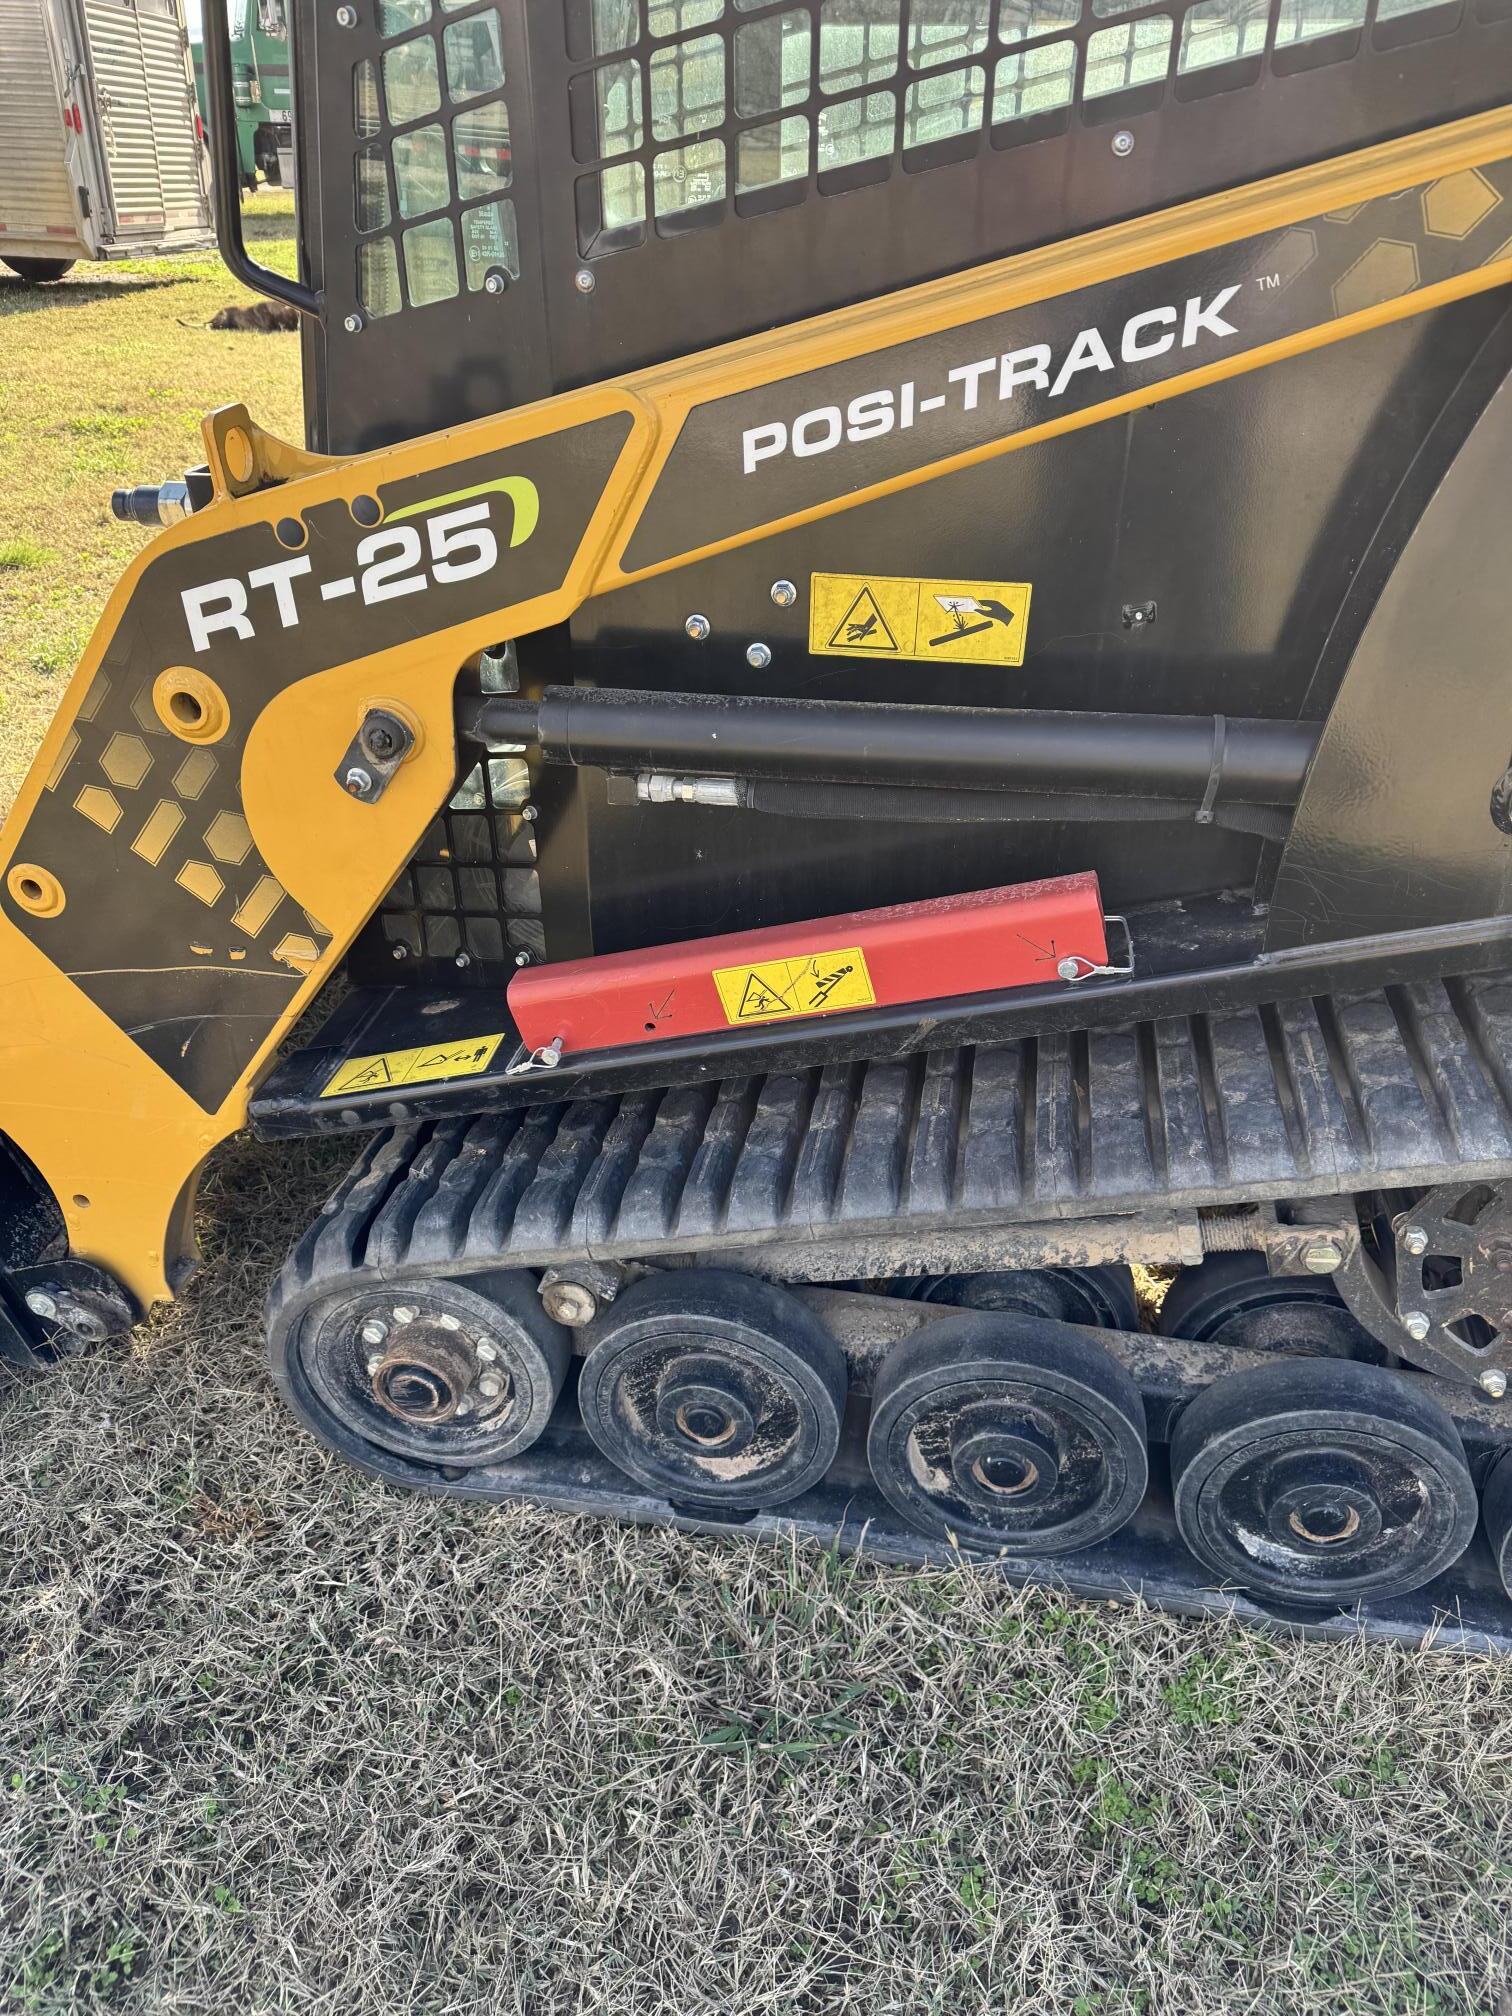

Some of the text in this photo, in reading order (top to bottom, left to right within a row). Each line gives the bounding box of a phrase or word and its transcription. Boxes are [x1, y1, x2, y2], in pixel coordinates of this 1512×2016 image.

[742, 272, 1281, 475] POSI-TRACK TM
[180, 501, 498, 653] RT-25
